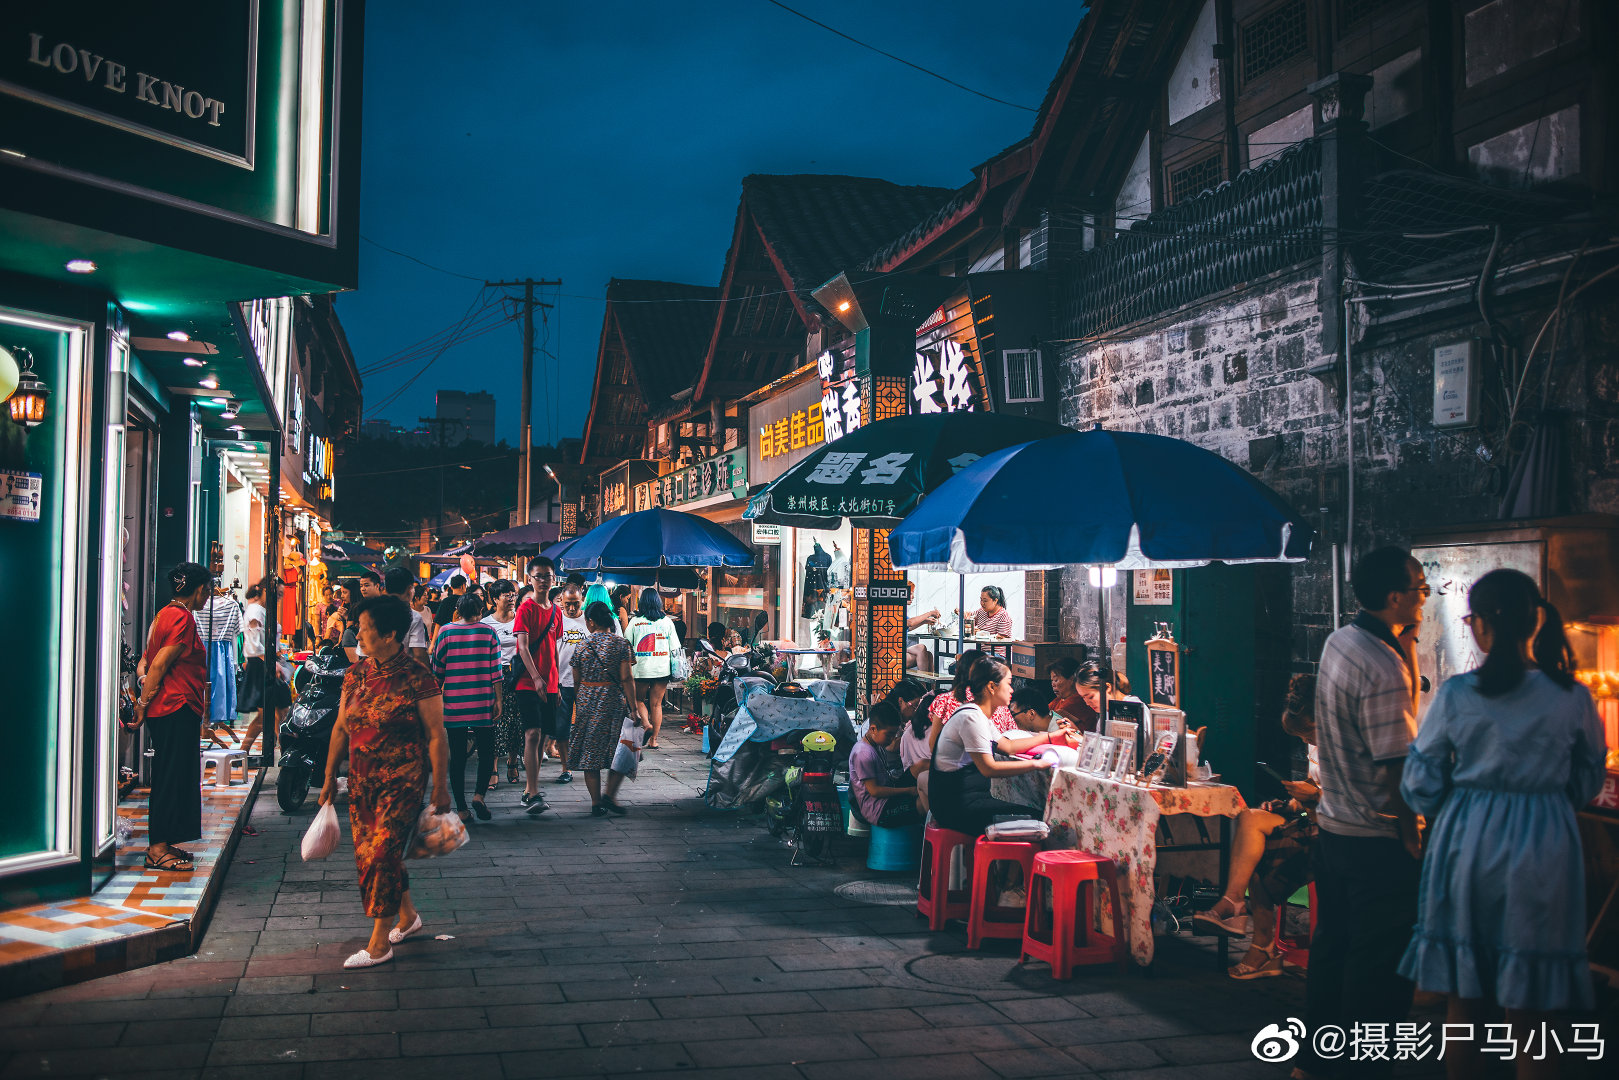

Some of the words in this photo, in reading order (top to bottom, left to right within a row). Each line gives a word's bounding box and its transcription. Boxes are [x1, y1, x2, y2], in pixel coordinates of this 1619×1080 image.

[28, 32, 127, 94] LOVE
[135, 71, 226, 127] KNOT
[759, 401, 825, 461] 尚美佳品
[805, 451, 914, 485] 题名
[787, 494, 896, 515] 崇州校区：大北街67号
